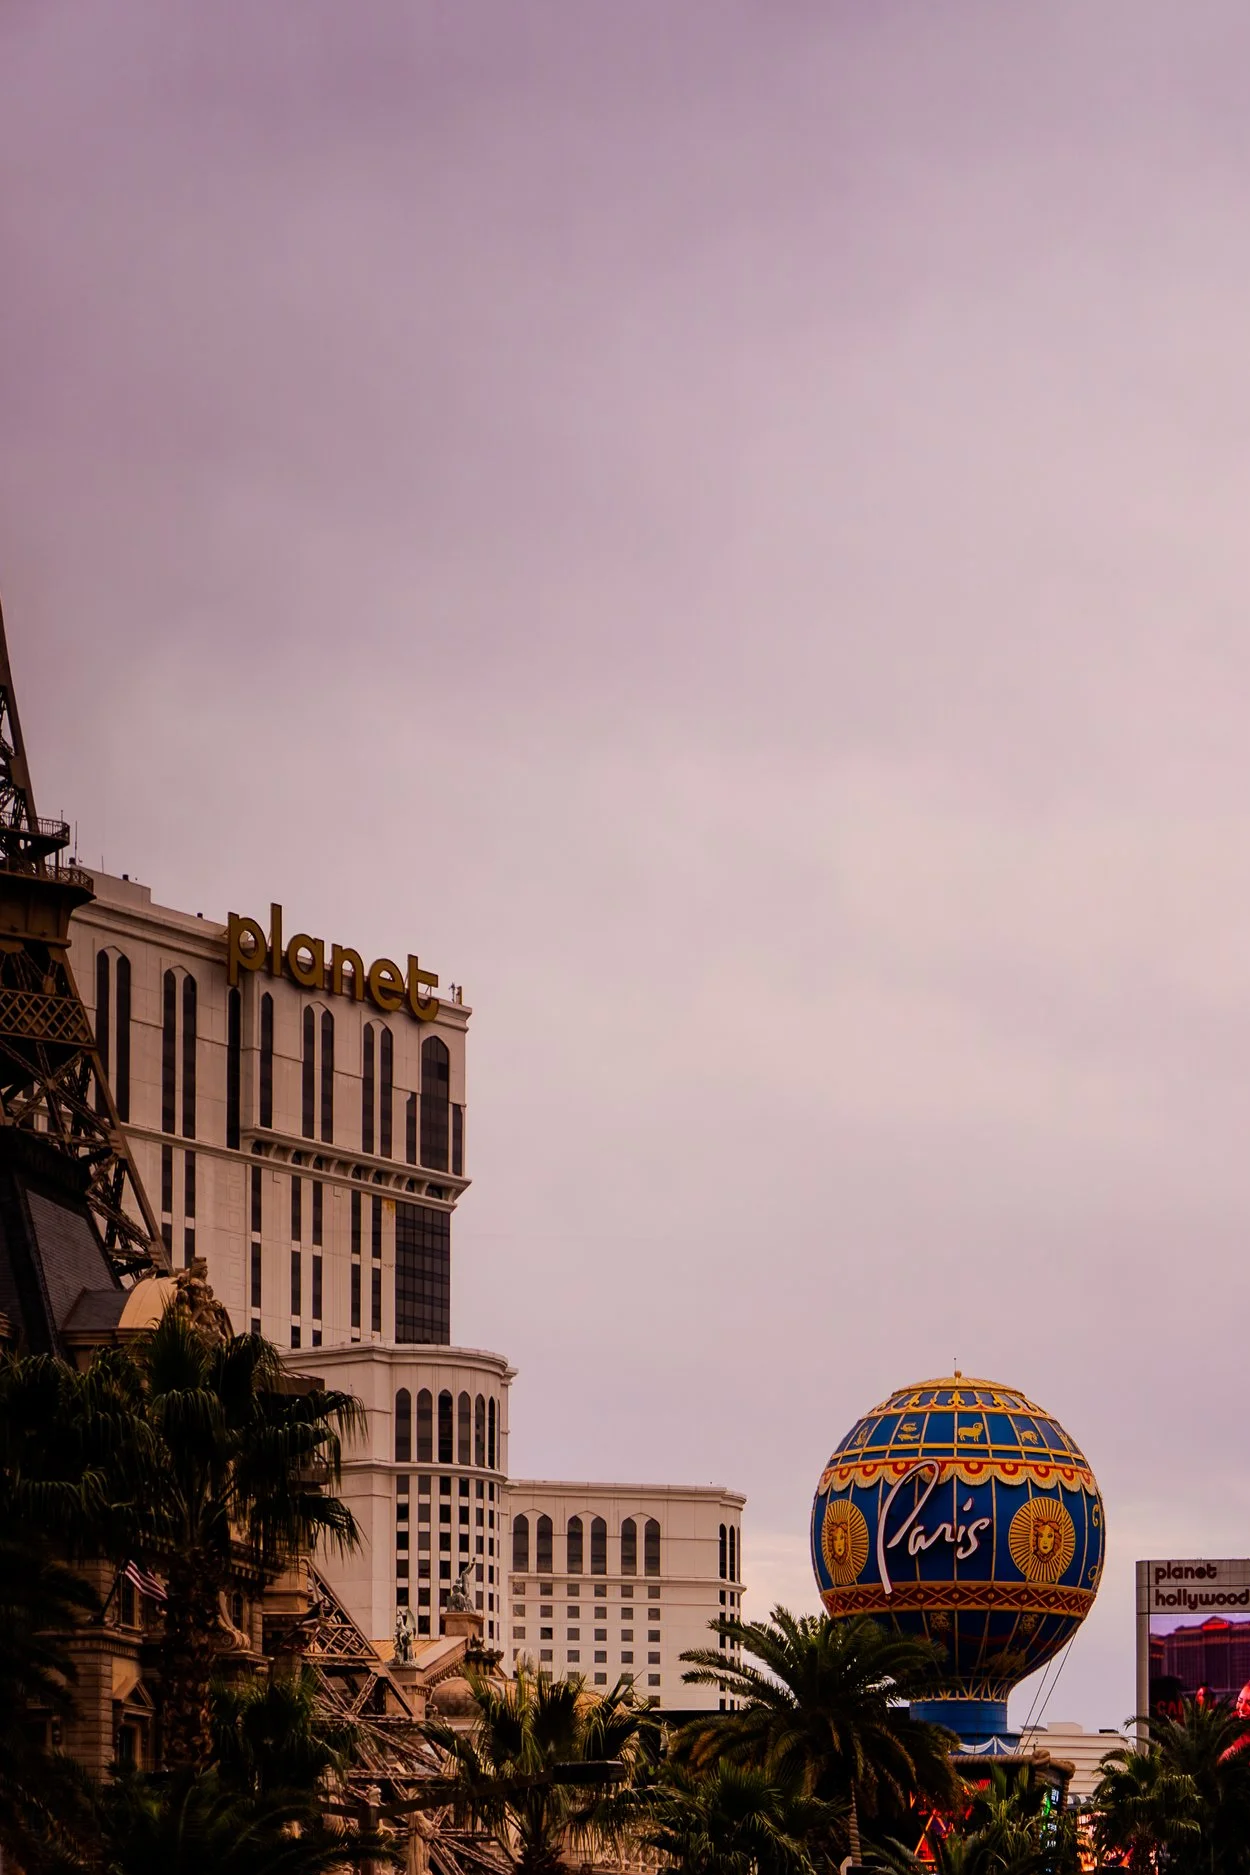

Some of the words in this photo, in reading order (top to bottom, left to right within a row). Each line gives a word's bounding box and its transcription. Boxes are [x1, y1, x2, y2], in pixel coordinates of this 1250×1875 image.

[227, 903, 440, 1022] planet
[877, 1459, 993, 1595] Paris
[1155, 1561, 1217, 1585] planet
[1155, 1588, 1249, 1610] hollywood
